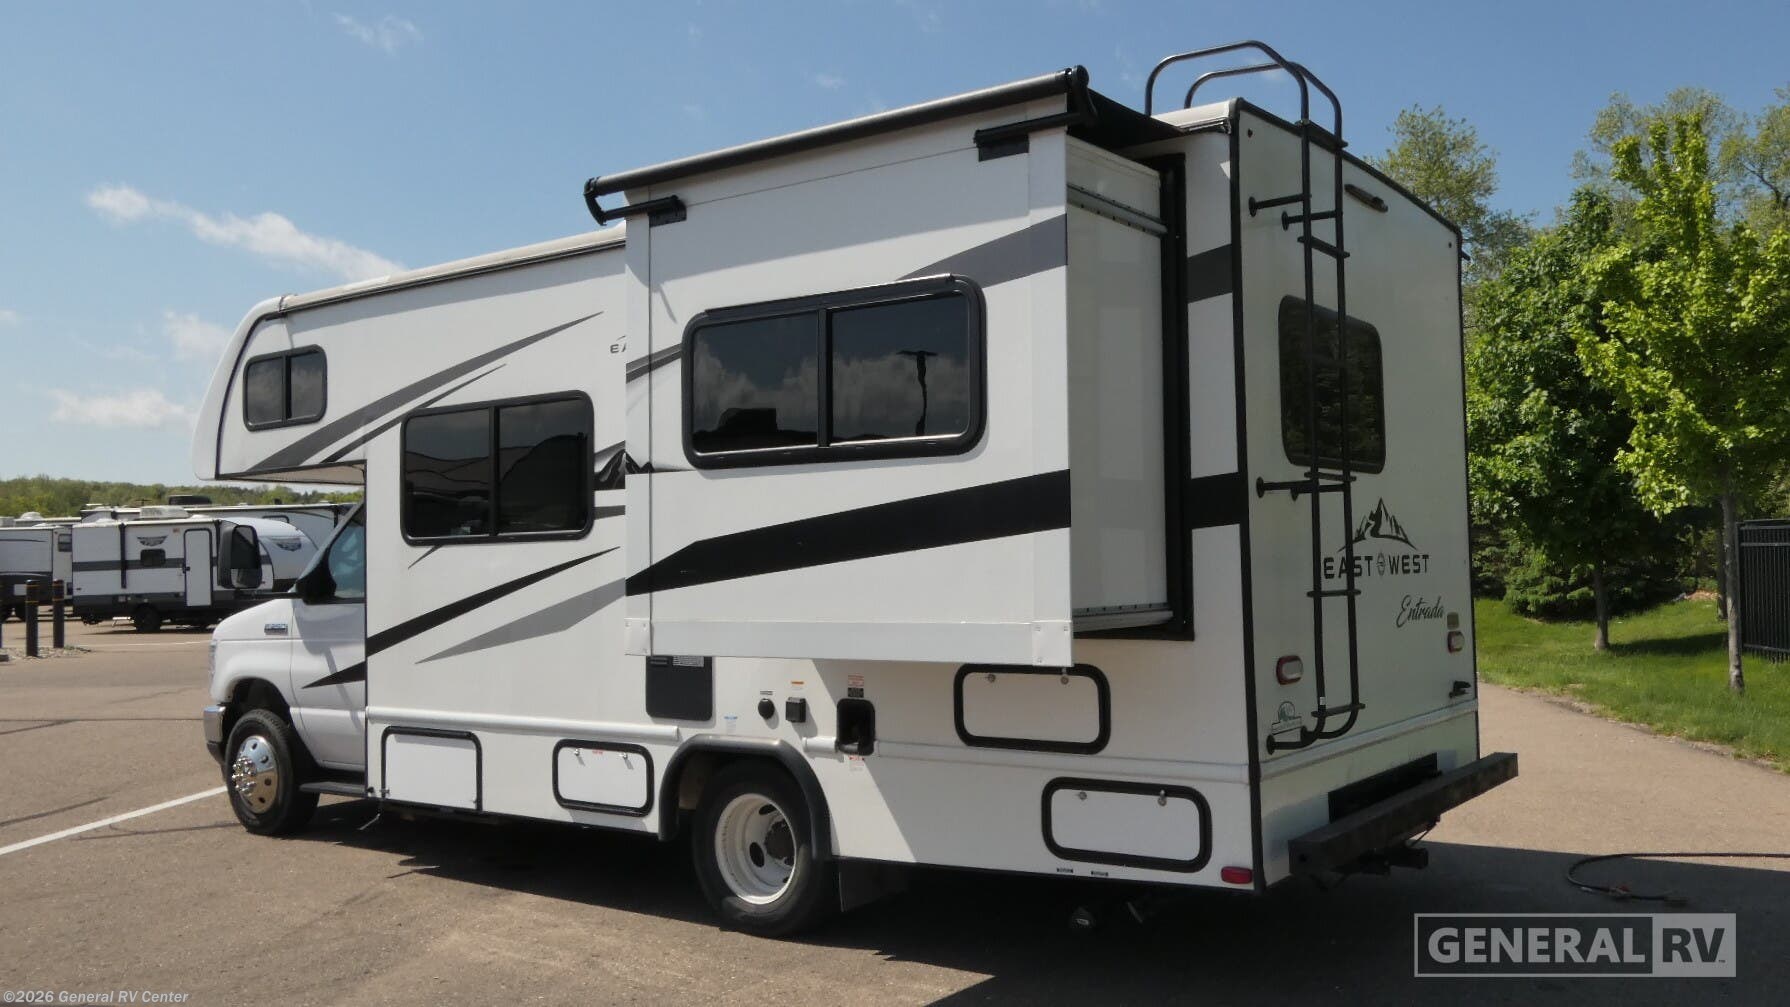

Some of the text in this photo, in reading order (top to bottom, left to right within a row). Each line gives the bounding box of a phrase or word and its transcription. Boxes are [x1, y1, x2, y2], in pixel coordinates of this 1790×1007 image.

[1323, 554, 1430, 579] EAST WEST
[1396, 595, 1444, 628] Entrada
